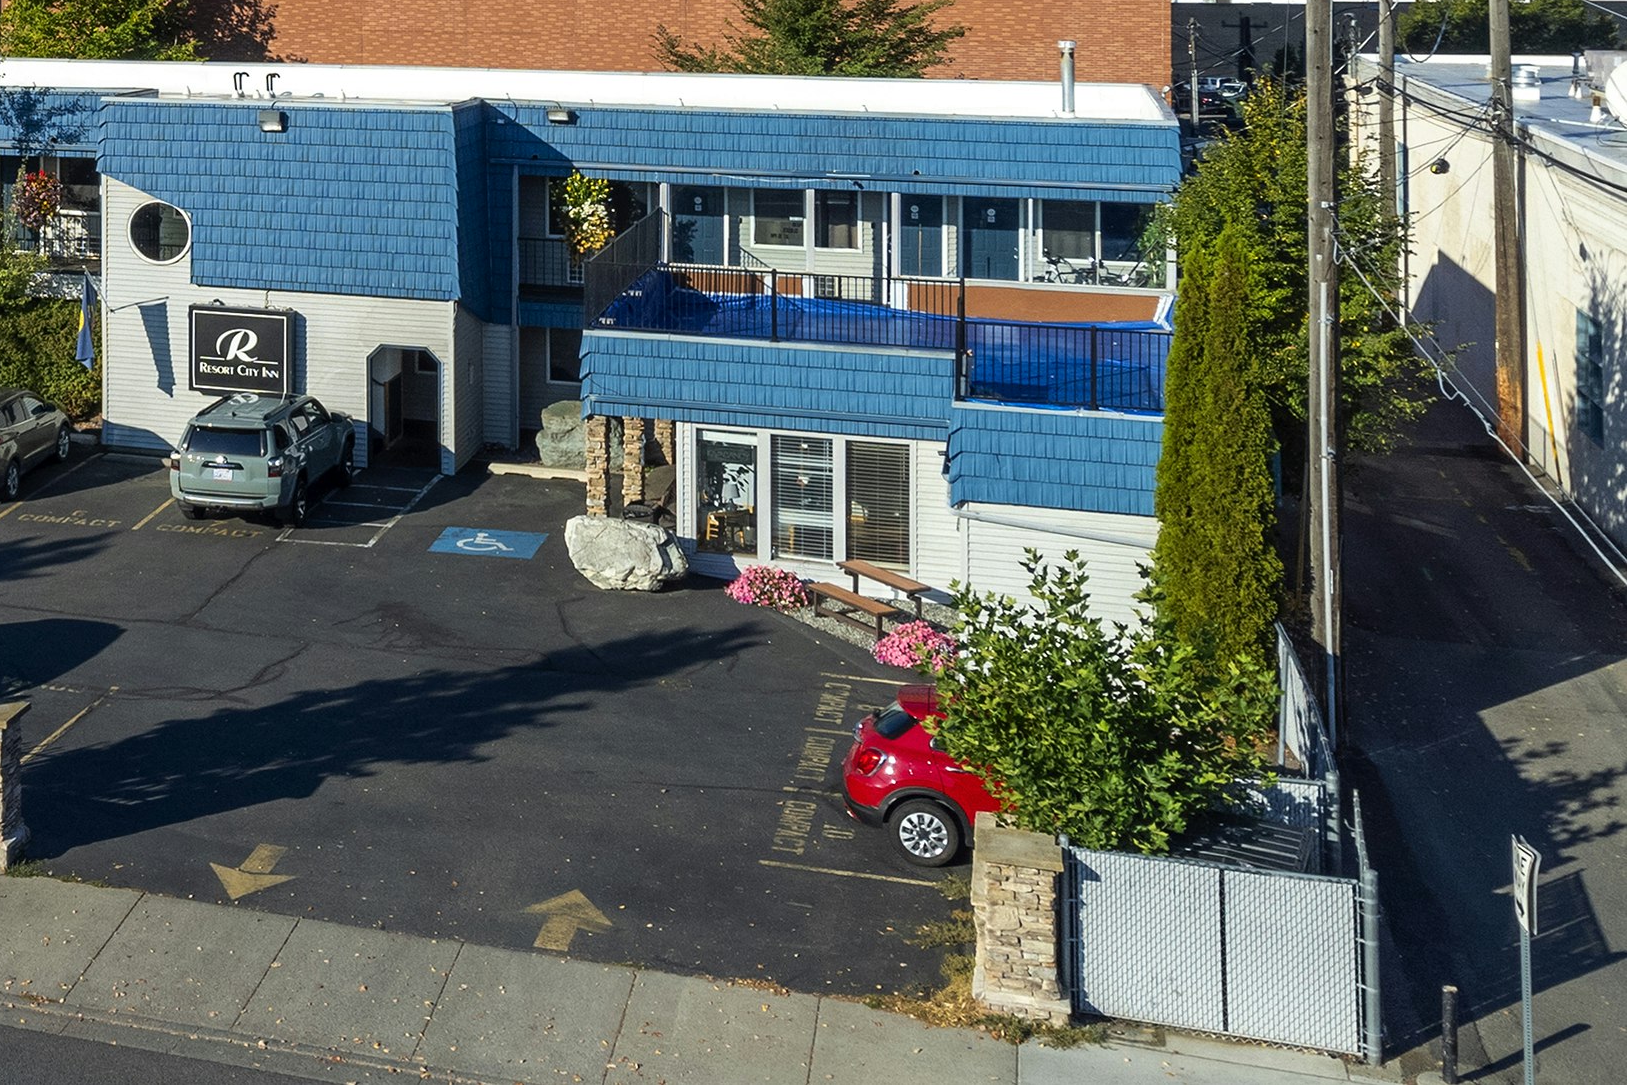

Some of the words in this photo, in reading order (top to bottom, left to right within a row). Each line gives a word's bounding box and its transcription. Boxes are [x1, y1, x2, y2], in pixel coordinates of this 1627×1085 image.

[215, 328, 259, 362] R
[200, 362, 234, 375] RESORT
[237, 365, 260, 377] CITY
[262, 366, 279, 379] INN
[17, 513, 122, 528] COMPACT
[156, 523, 264, 538] COMPACT
[772, 800, 817, 856] COMPACT
